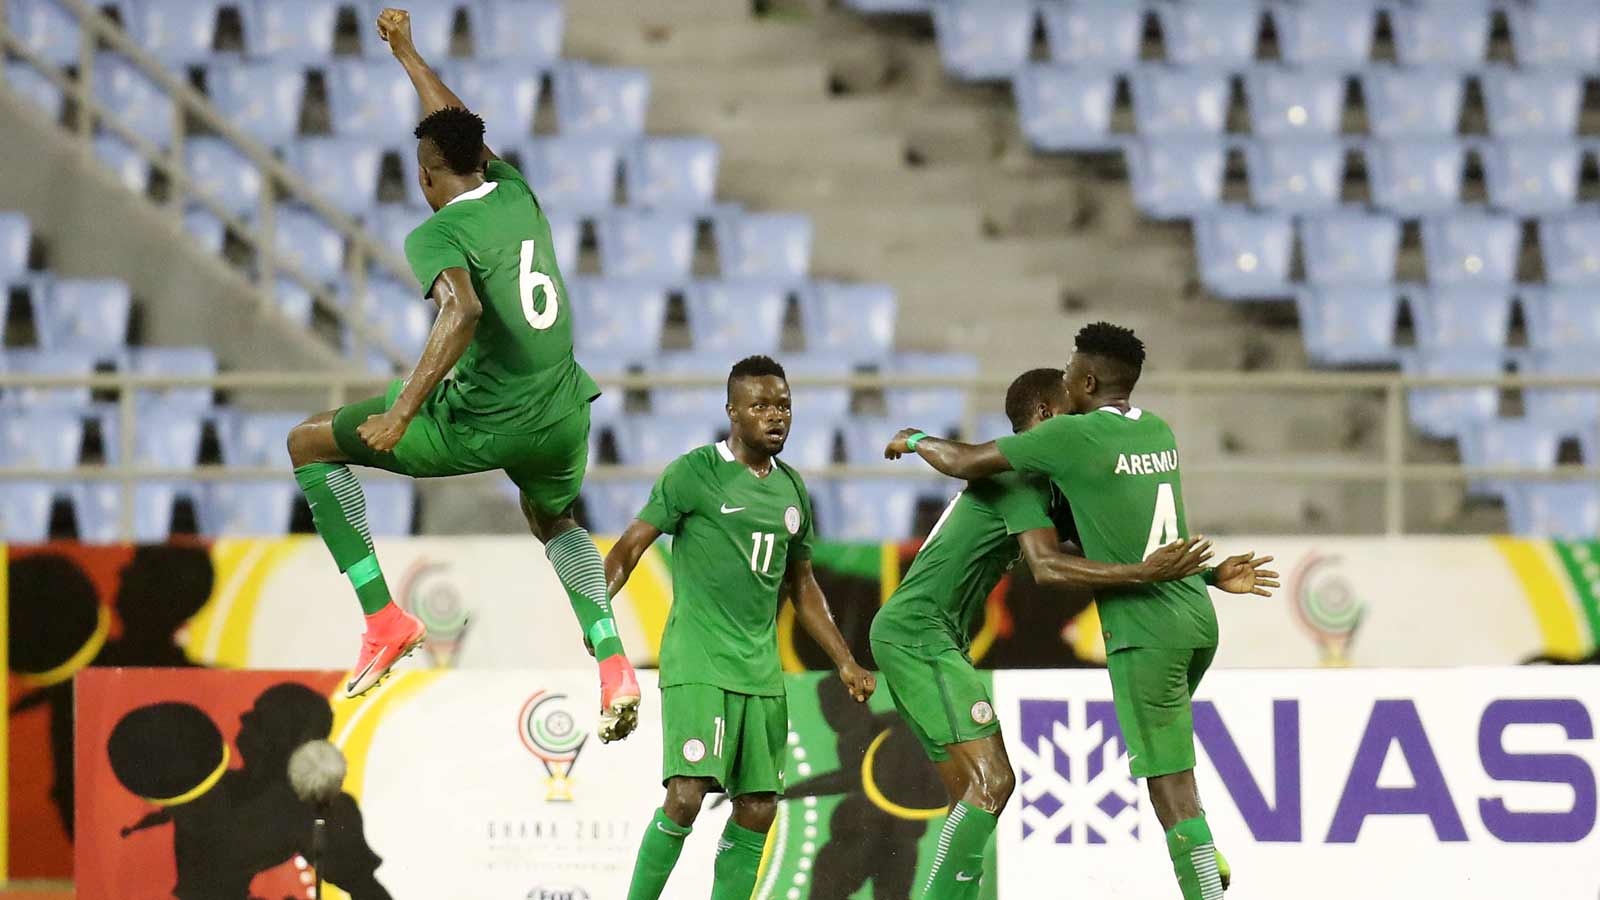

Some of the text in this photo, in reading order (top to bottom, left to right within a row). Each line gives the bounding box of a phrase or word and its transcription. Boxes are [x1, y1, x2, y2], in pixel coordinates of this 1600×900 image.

[519, 239, 559, 330] 6
[1114, 449, 1178, 475] AREMU
[751, 531, 775, 573] 11
[1142, 483, 1179, 562] 4
